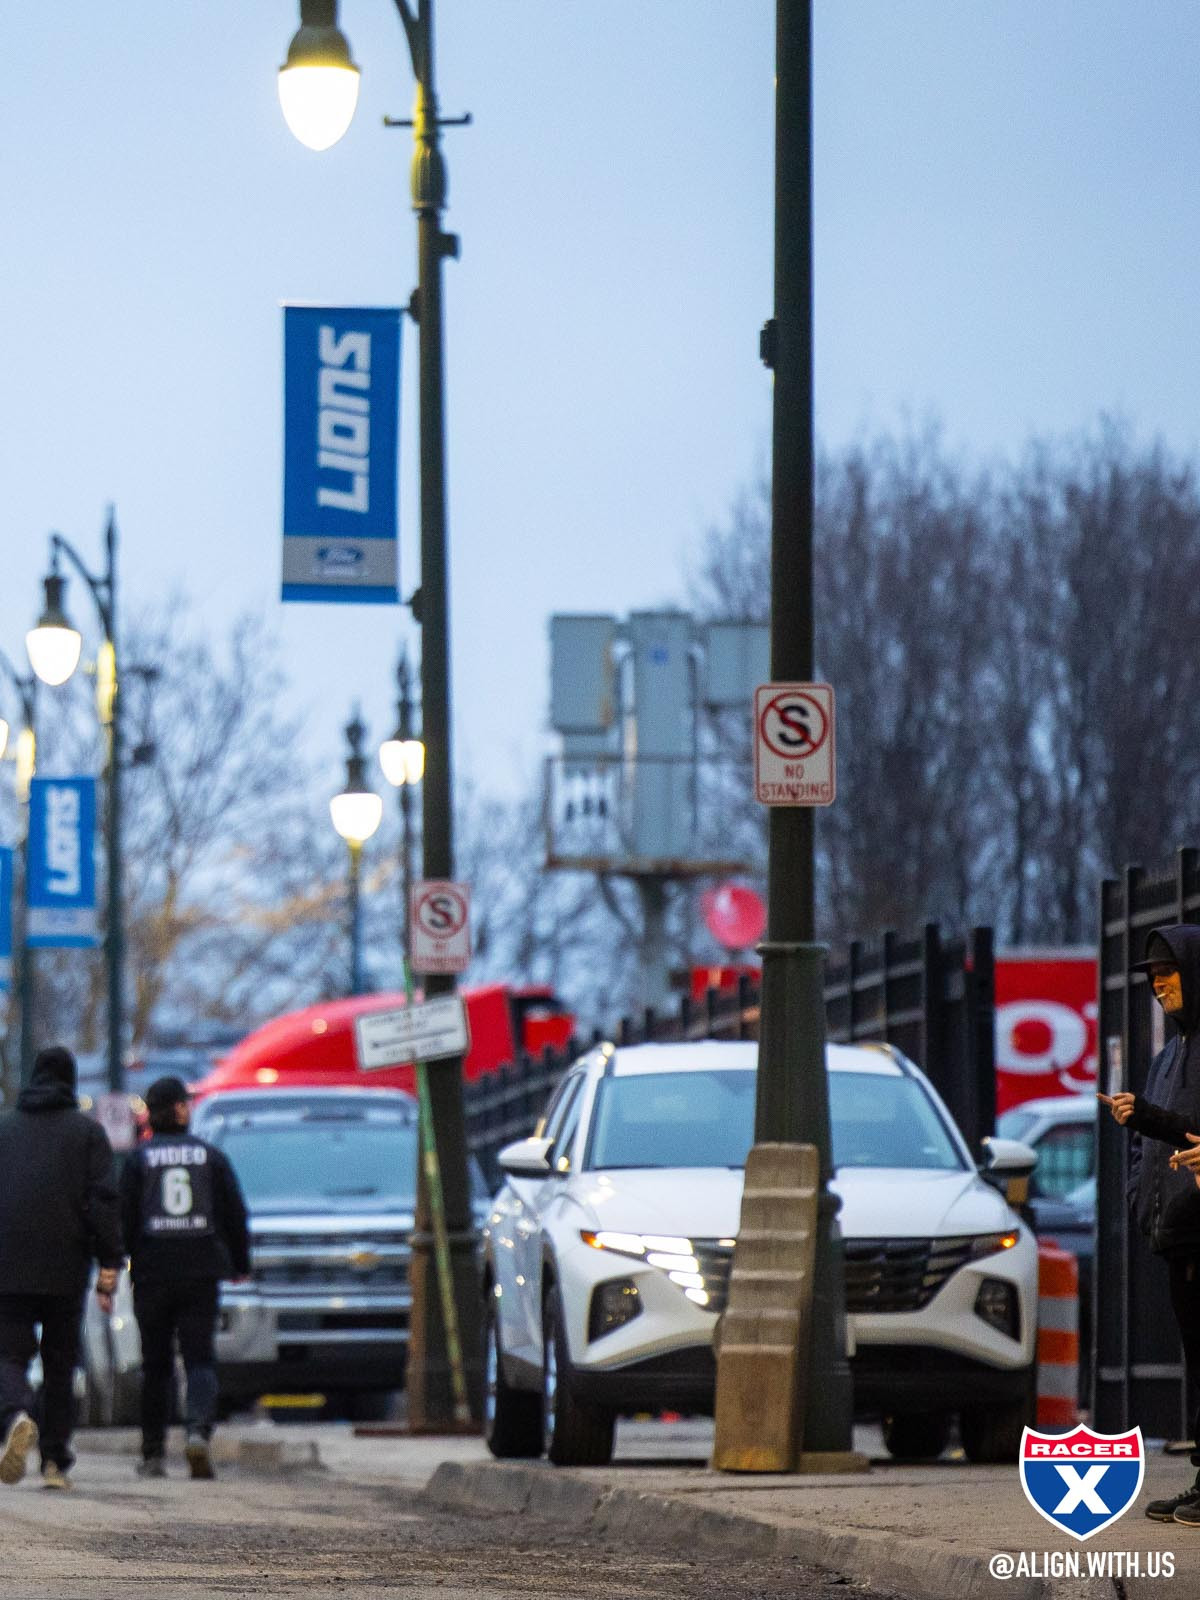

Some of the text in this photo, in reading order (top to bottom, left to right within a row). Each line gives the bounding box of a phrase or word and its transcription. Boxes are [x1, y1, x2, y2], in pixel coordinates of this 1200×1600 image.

[316, 325, 372, 514] LIONS
[783, 764, 804, 780] NO
[761, 783, 829, 798] STANDING
[161, 1167, 193, 1216] 6
